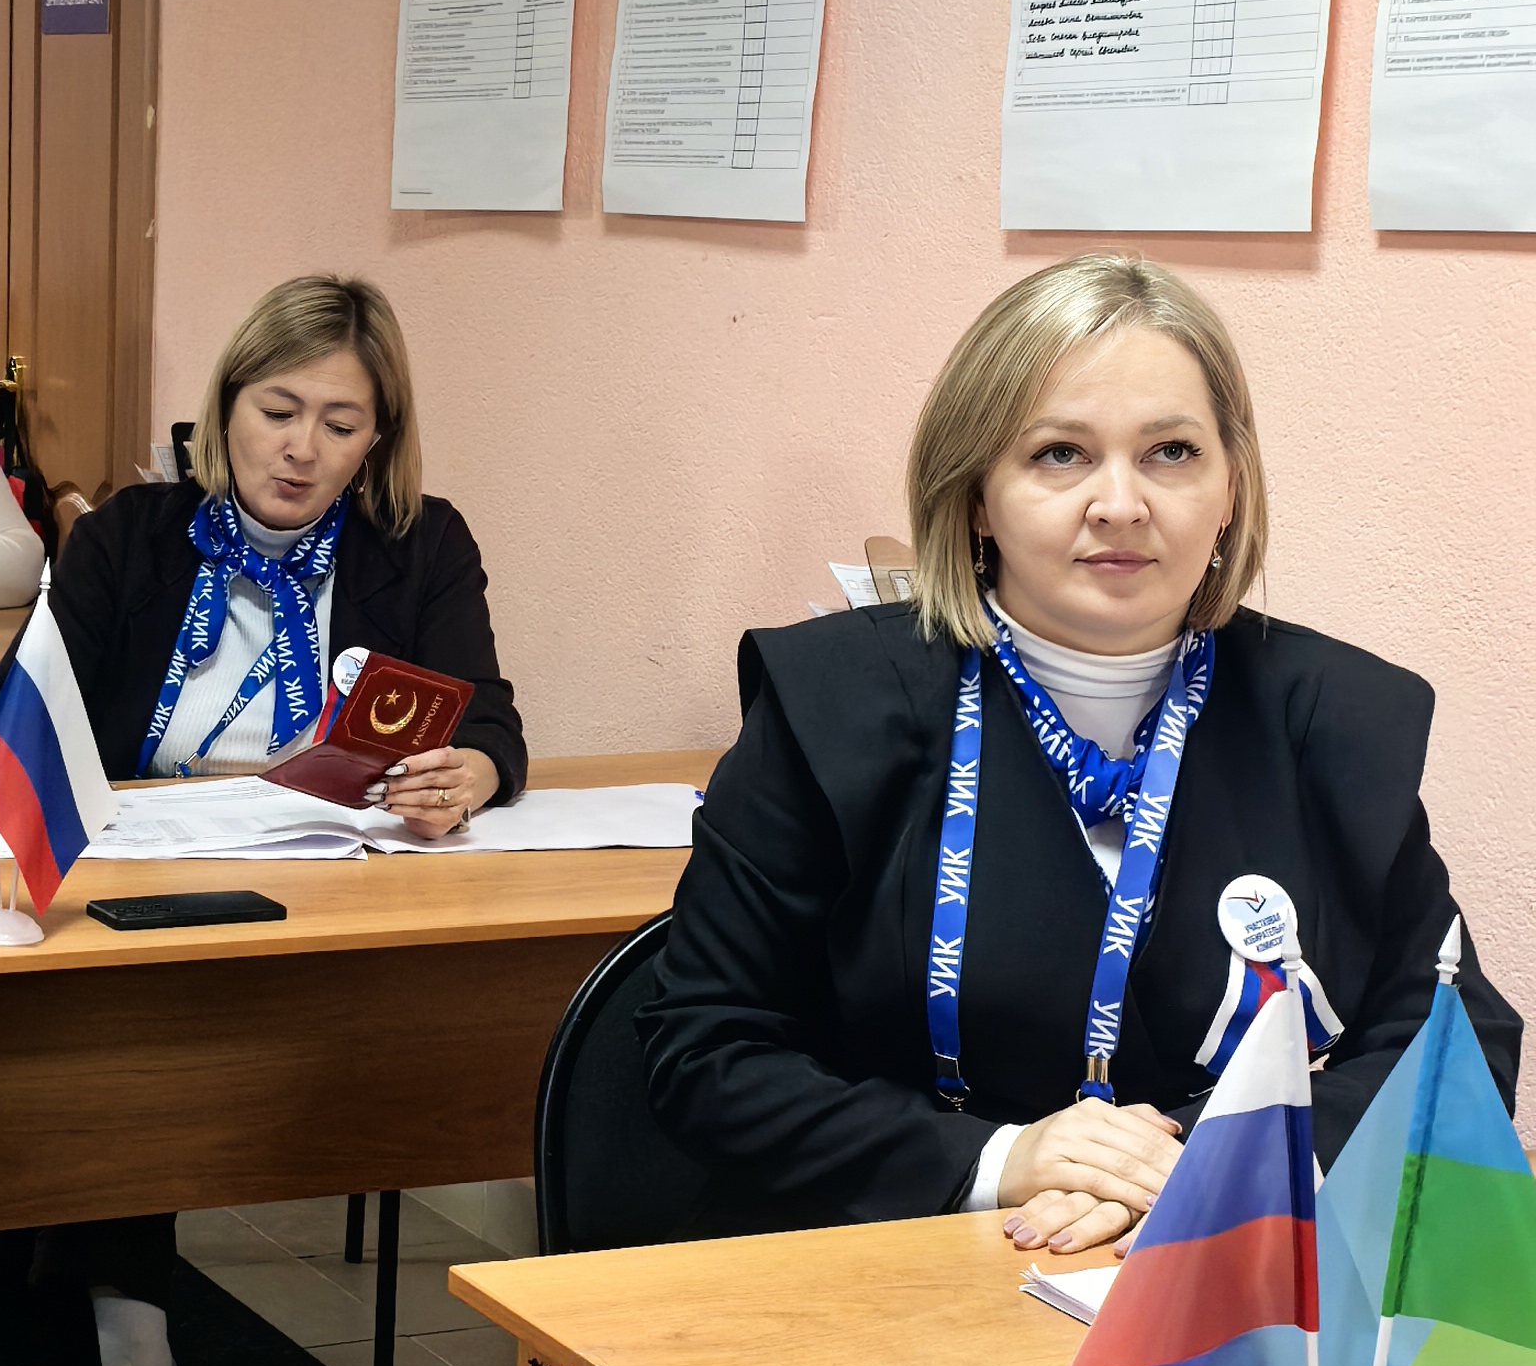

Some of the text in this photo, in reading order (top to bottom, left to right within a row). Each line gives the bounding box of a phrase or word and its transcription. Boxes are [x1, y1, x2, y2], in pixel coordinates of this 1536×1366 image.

[312, 536, 334, 575] УИК
[191, 608, 211, 650] УИК
[276, 627, 297, 672] УИК
[165, 648, 189, 686] УИК
[249, 647, 277, 684] УИК
[147, 701, 173, 739] УИК
[221, 691, 250, 726] УИК
[283, 676, 309, 722] УИК
[411, 694, 444, 746] PASSPORT
[955, 671, 980, 732] УИК
[1154, 698, 1188, 759] УИК
[946, 758, 978, 818] УИК
[1129, 792, 1171, 854] УИК
[938, 846, 971, 906] УИК
[1102, 894, 1144, 959] УИК
[930, 934, 962, 999] УИК
[1088, 999, 1121, 1061] УИК
